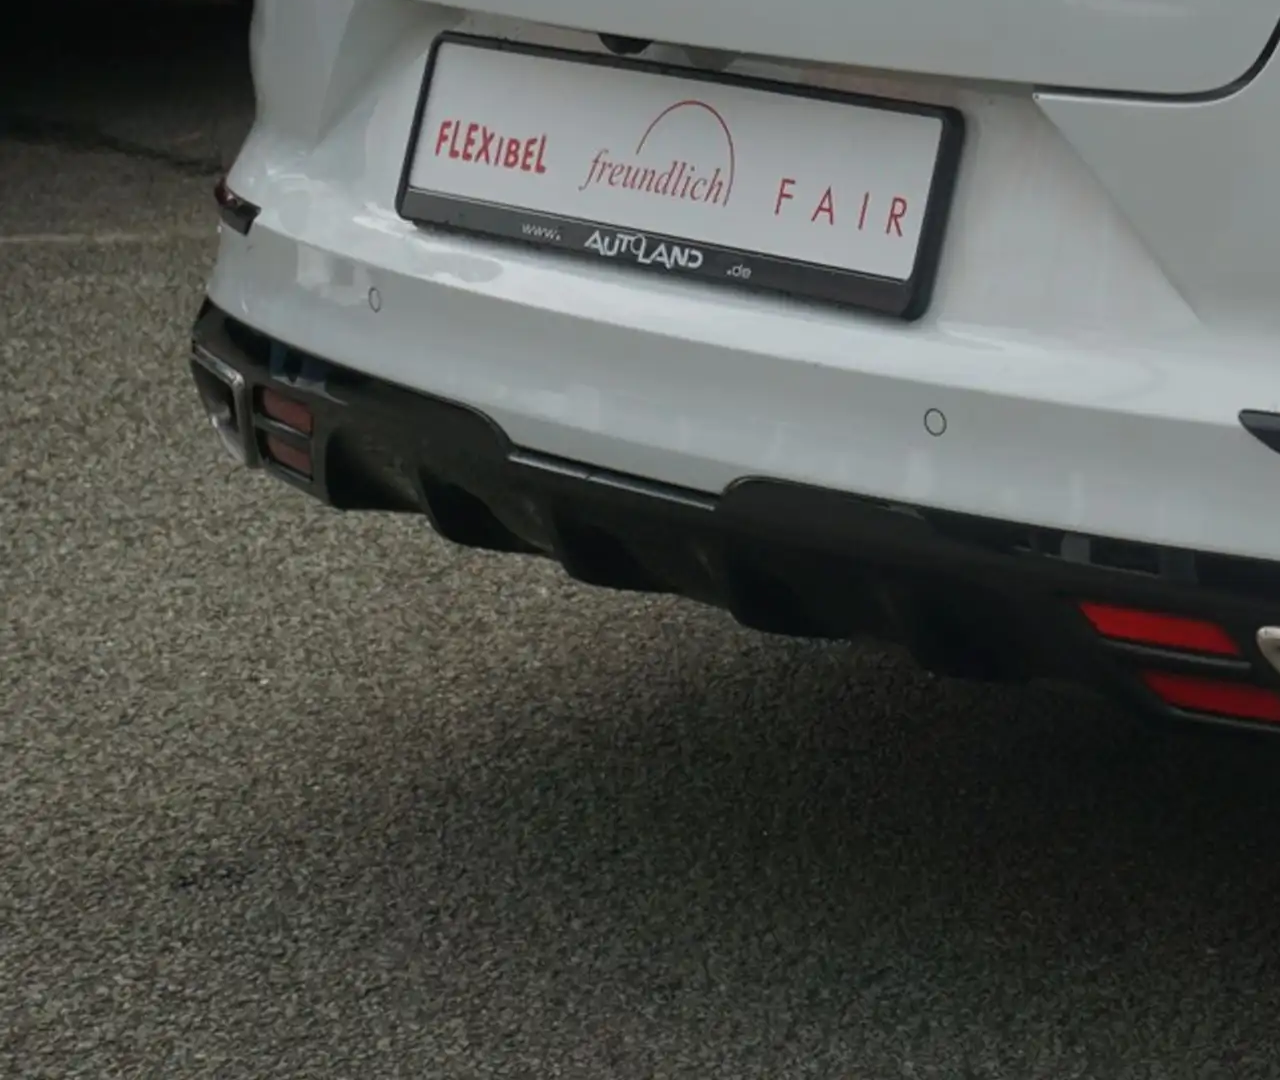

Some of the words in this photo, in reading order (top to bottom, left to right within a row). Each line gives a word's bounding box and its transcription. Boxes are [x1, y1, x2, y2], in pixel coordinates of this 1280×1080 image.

[434, 119, 548, 174] FLEXIBEL
[578, 148, 726, 205] freundlich
[773, 178, 908, 238] FAIR
[584, 229, 704, 270] AUTOLAND
